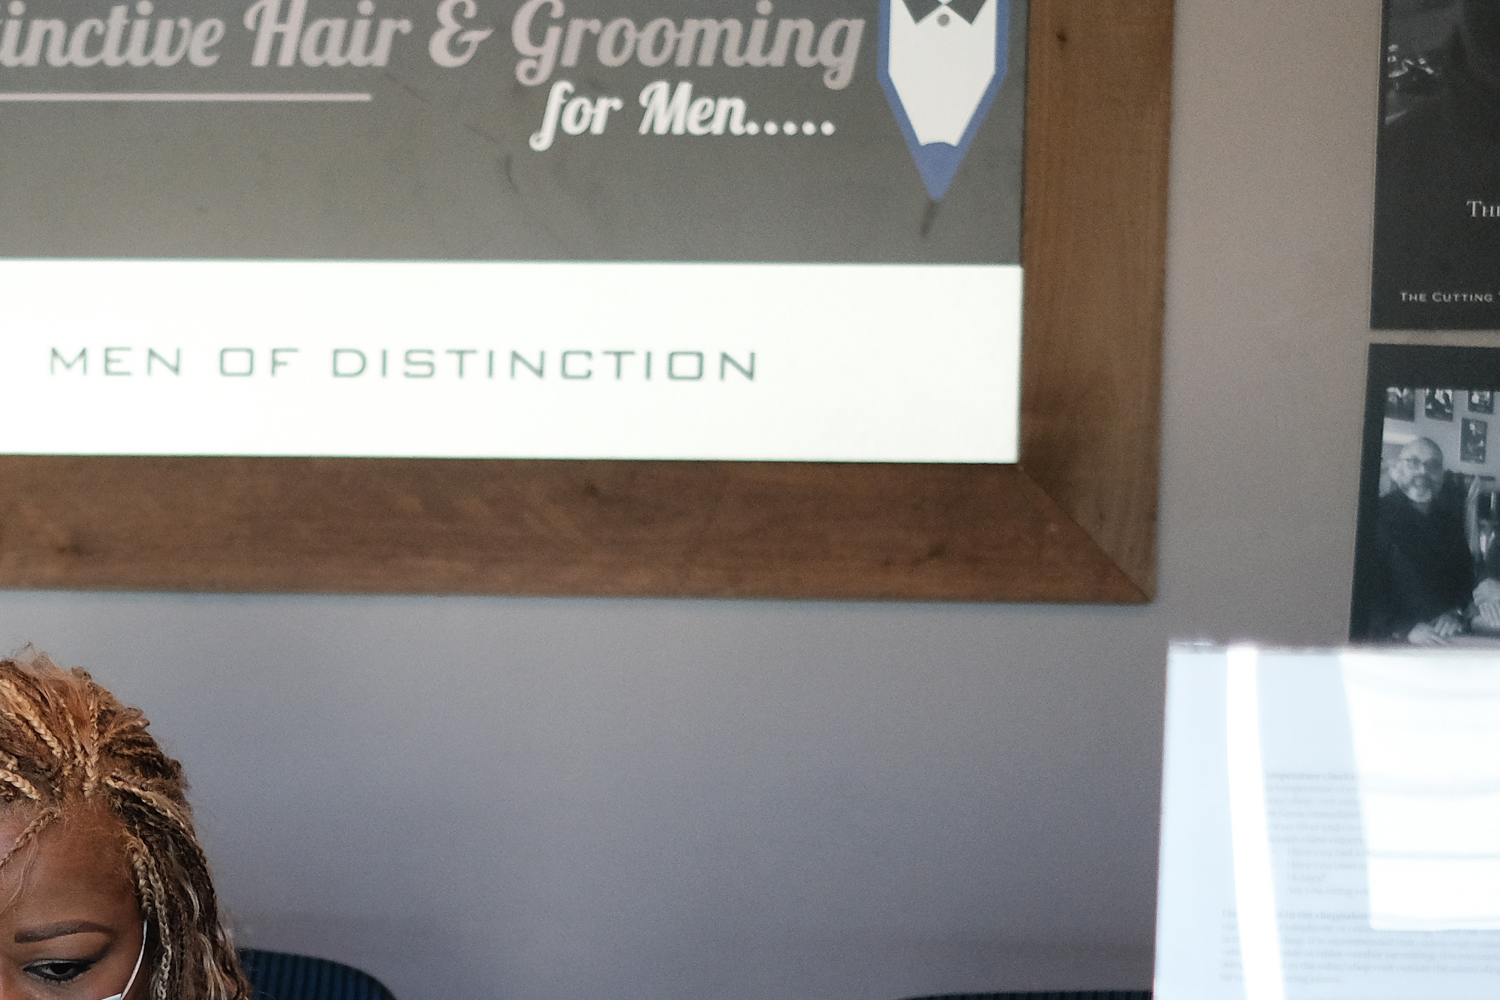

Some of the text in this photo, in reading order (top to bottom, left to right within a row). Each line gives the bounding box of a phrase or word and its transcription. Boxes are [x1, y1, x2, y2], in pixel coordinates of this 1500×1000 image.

[243, 0, 412, 68] Hair
[428, 0, 494, 68] &
[511, 0, 866, 90] Grooming
[529, 81, 623, 151] for
[49, 346, 757, 383] MEN OF DISTINCTION
